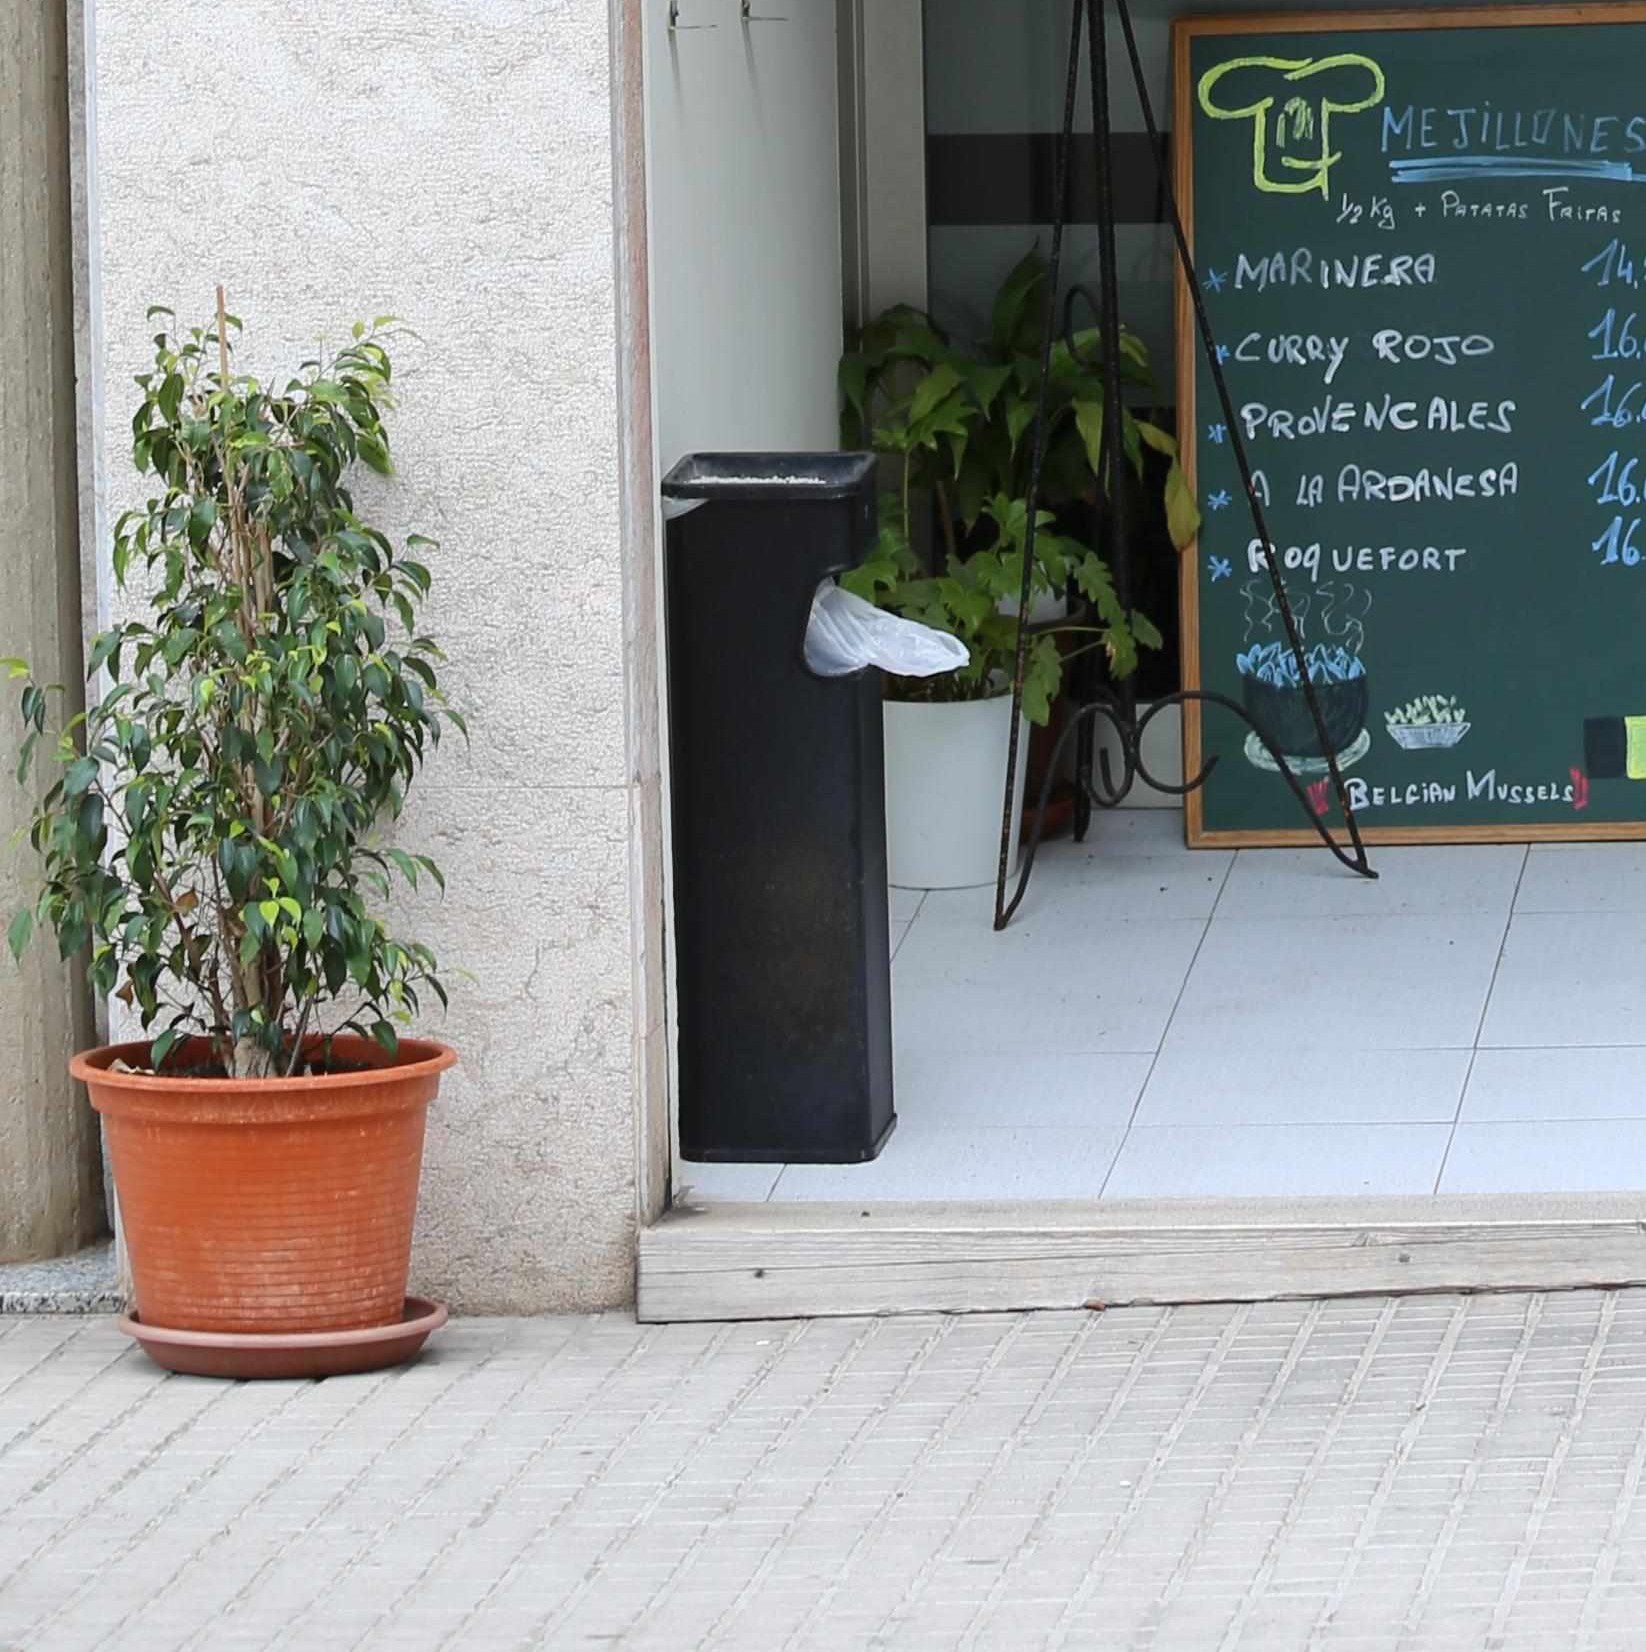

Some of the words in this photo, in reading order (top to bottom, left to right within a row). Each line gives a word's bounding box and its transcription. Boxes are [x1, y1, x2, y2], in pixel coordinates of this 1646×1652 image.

[1234, 247, 1436, 292] MARINERA
[1234, 331, 1349, 385] CURRY
[1371, 329, 1494, 365] ROJO
[1240, 394, 1517, 440] PROVENCALES
[1296, 473, 1324, 508] LA
[1337, 461, 1518, 503] ARDANESA
